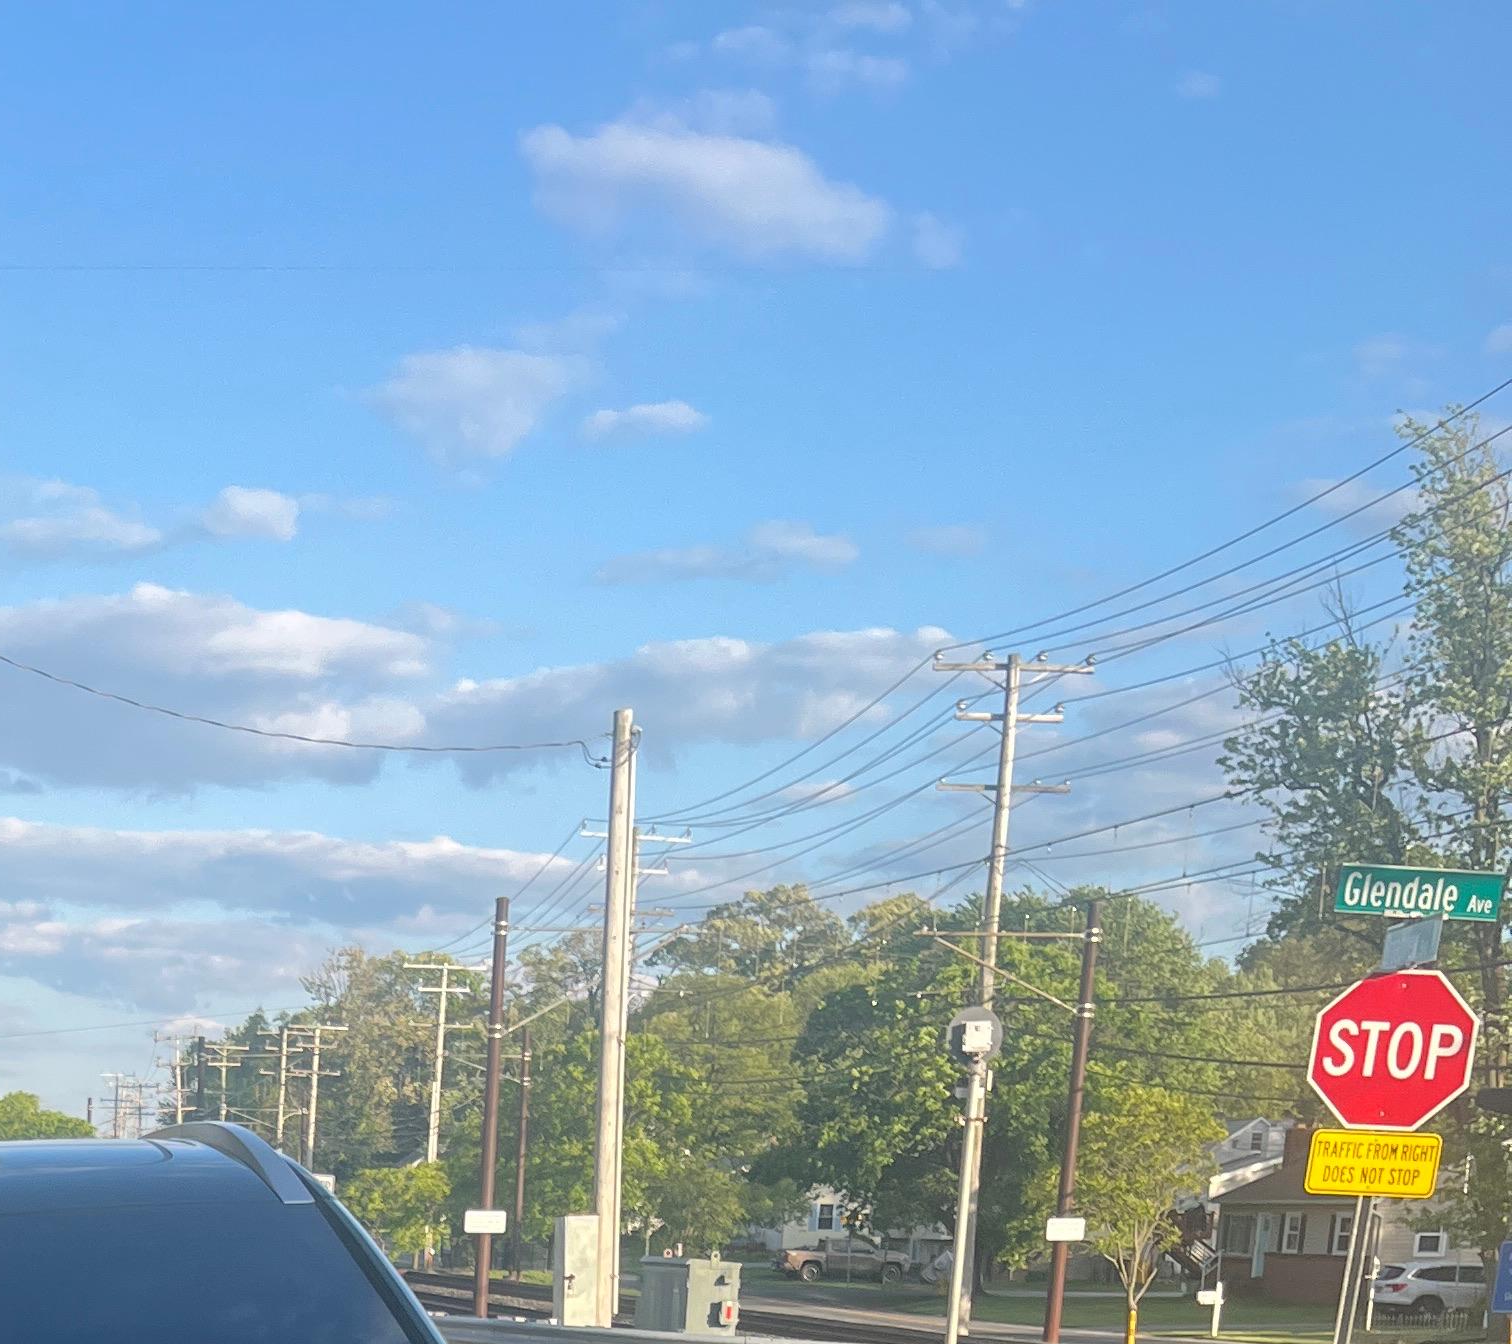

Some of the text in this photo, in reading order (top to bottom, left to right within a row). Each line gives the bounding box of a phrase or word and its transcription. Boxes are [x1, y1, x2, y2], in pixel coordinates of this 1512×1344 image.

[1343, 870, 1493, 914] Glendale Ave
[1322, 1018, 1464, 1080] STOP
[1316, 1140, 1438, 1163] TRAFFIC FROM RIGHT
[1322, 1165, 1420, 1187] DOES NOT STOP
